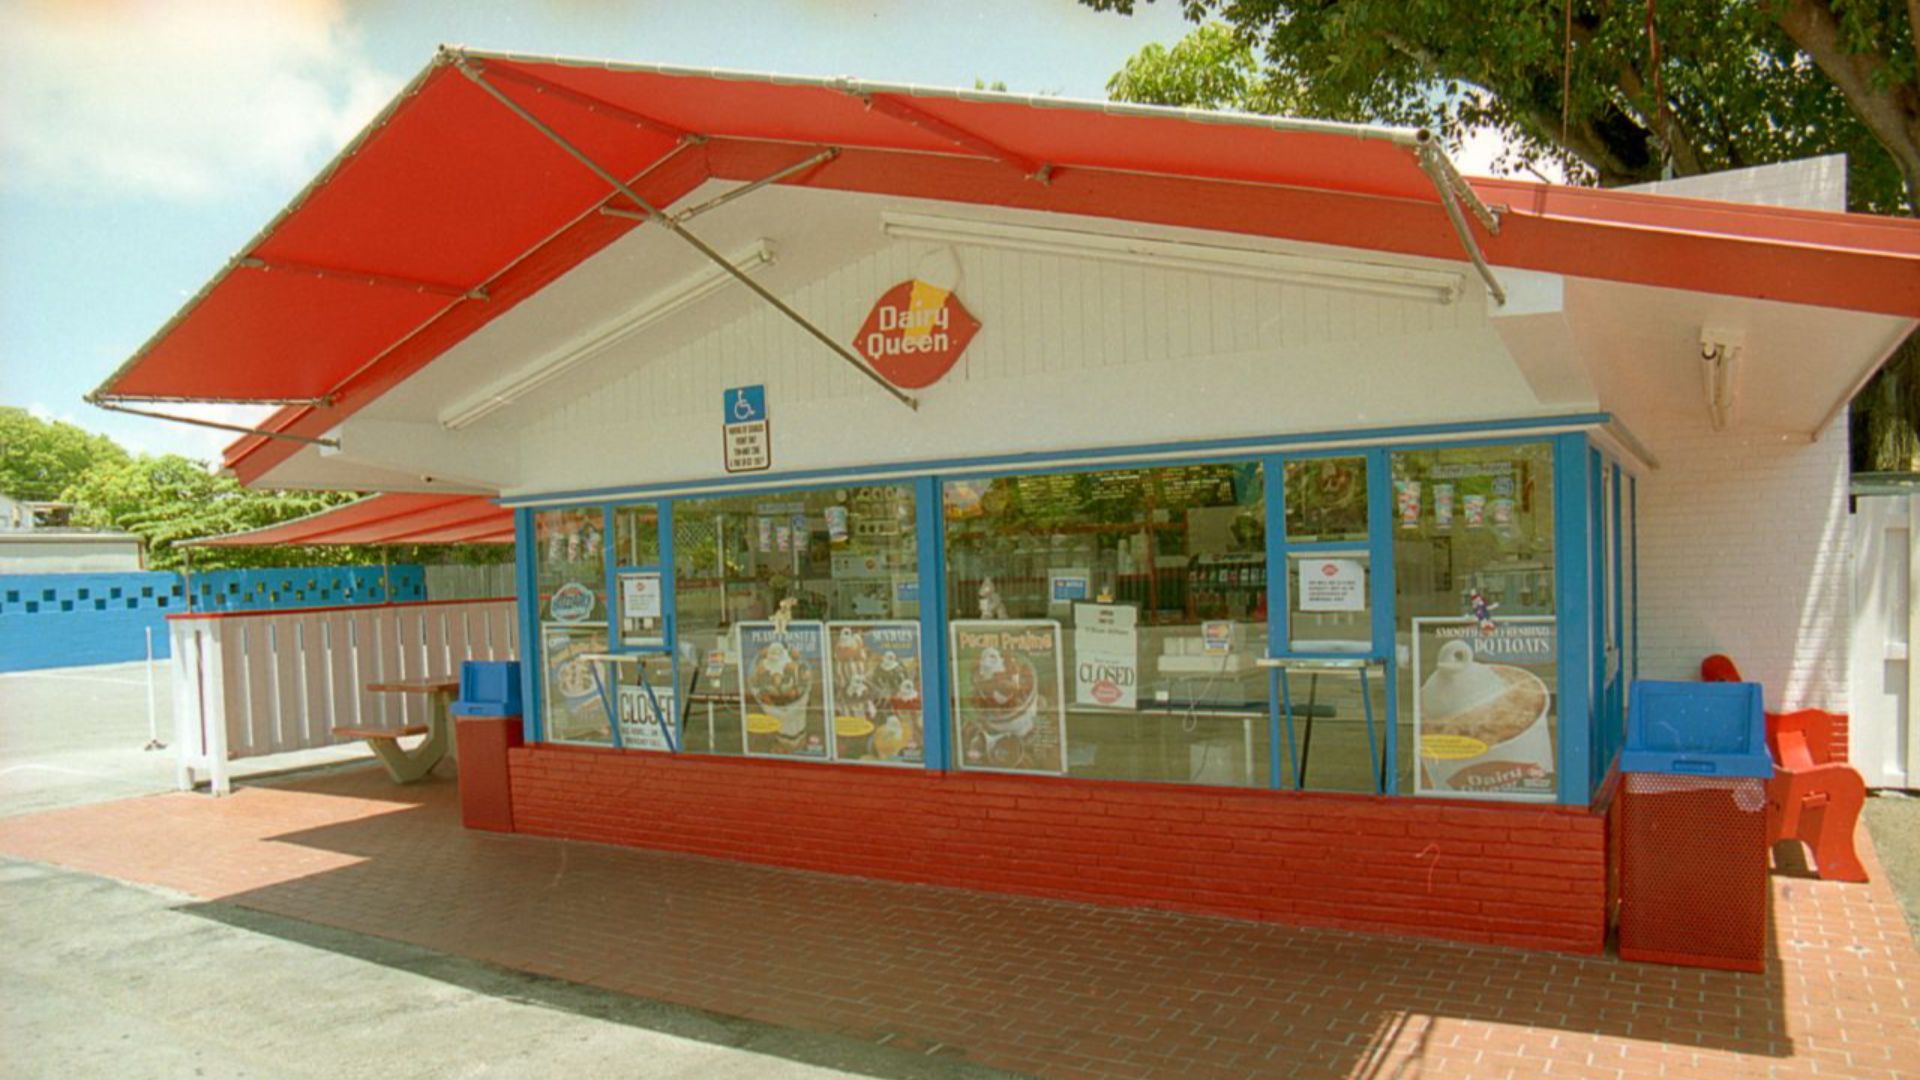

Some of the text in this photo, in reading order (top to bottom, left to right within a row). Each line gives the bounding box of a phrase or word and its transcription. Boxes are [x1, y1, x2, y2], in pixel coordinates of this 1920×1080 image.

[879, 306, 949, 330] Dairy
[867, 332, 948, 359] Queen
[1079, 662, 1135, 686] CLOSED
